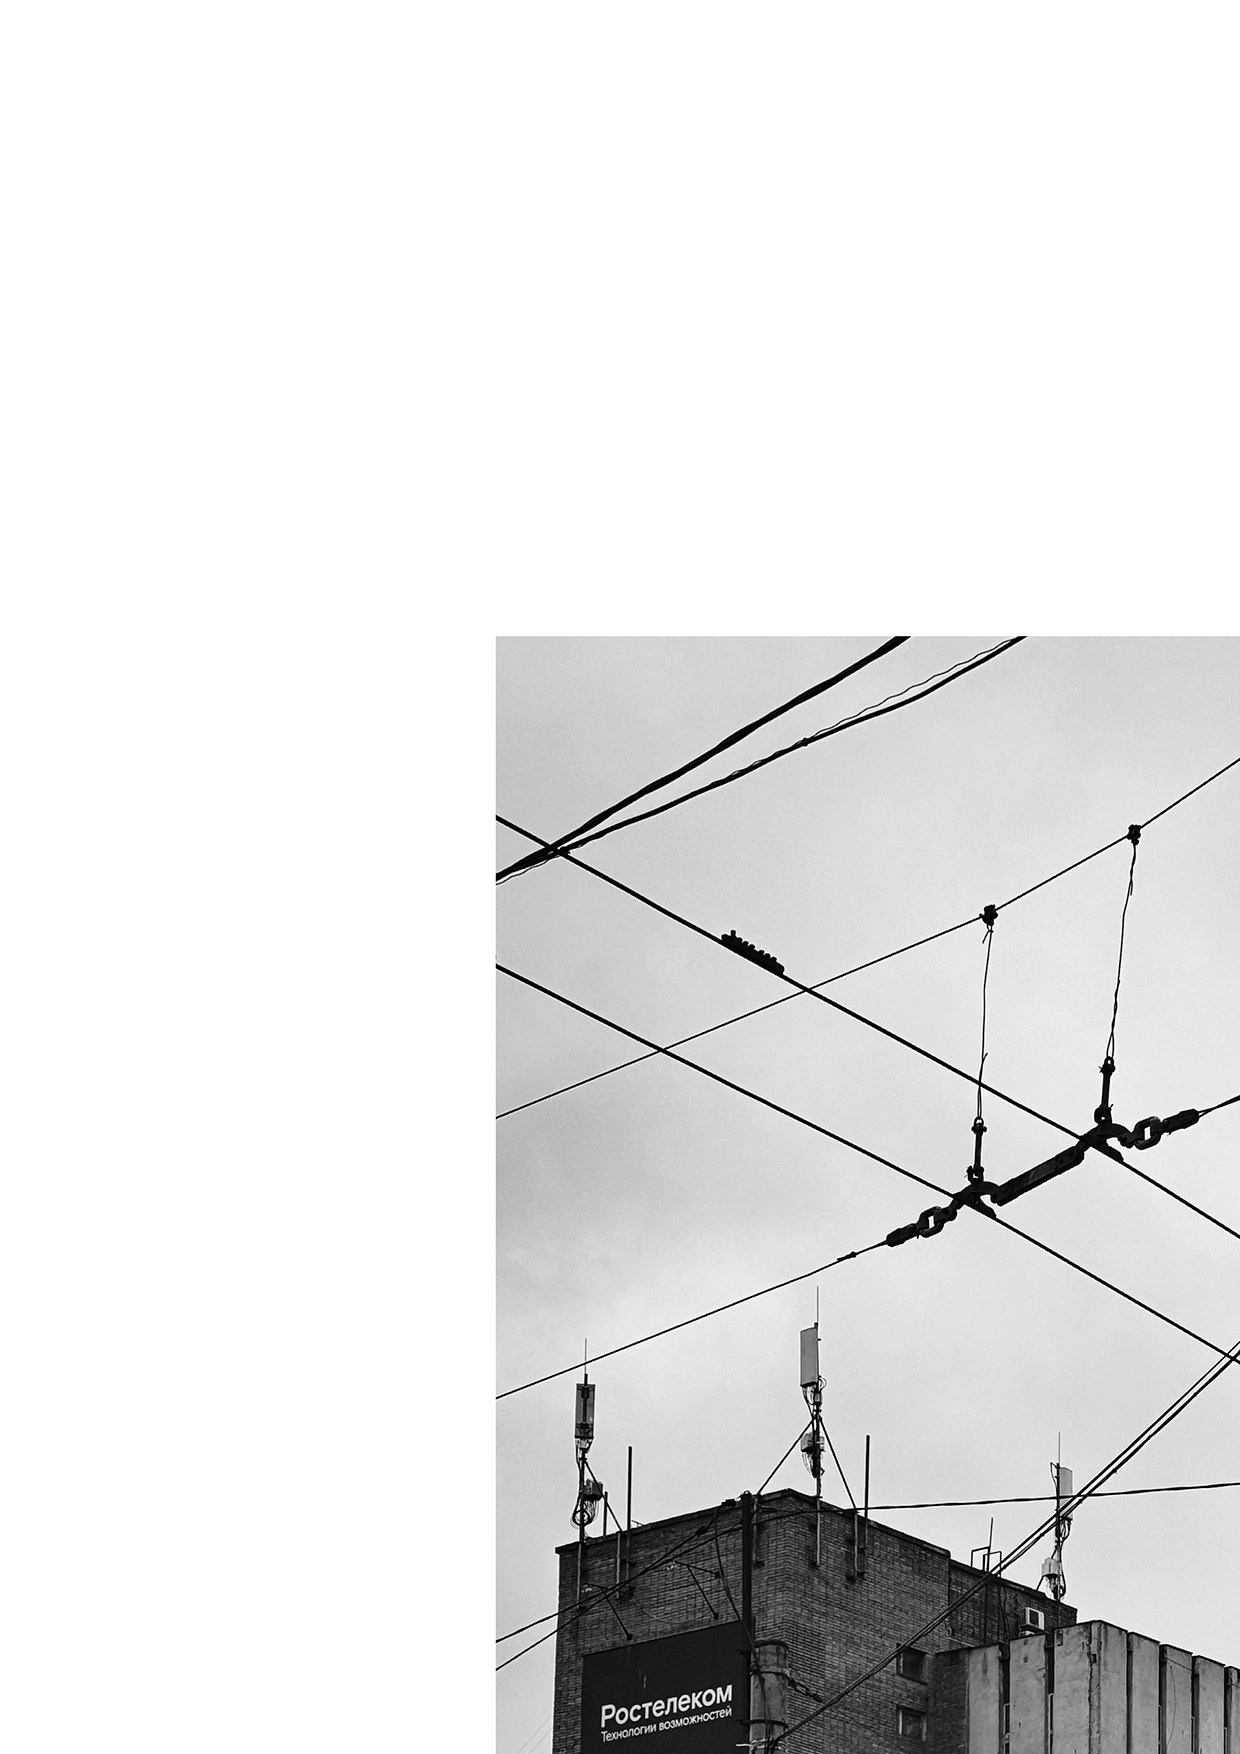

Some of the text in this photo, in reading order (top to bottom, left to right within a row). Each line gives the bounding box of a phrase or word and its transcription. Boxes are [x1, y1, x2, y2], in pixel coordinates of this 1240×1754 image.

[601, 1684, 733, 1728] Ростелеком
[601, 1705, 732, 1742] Технологии возможностей
